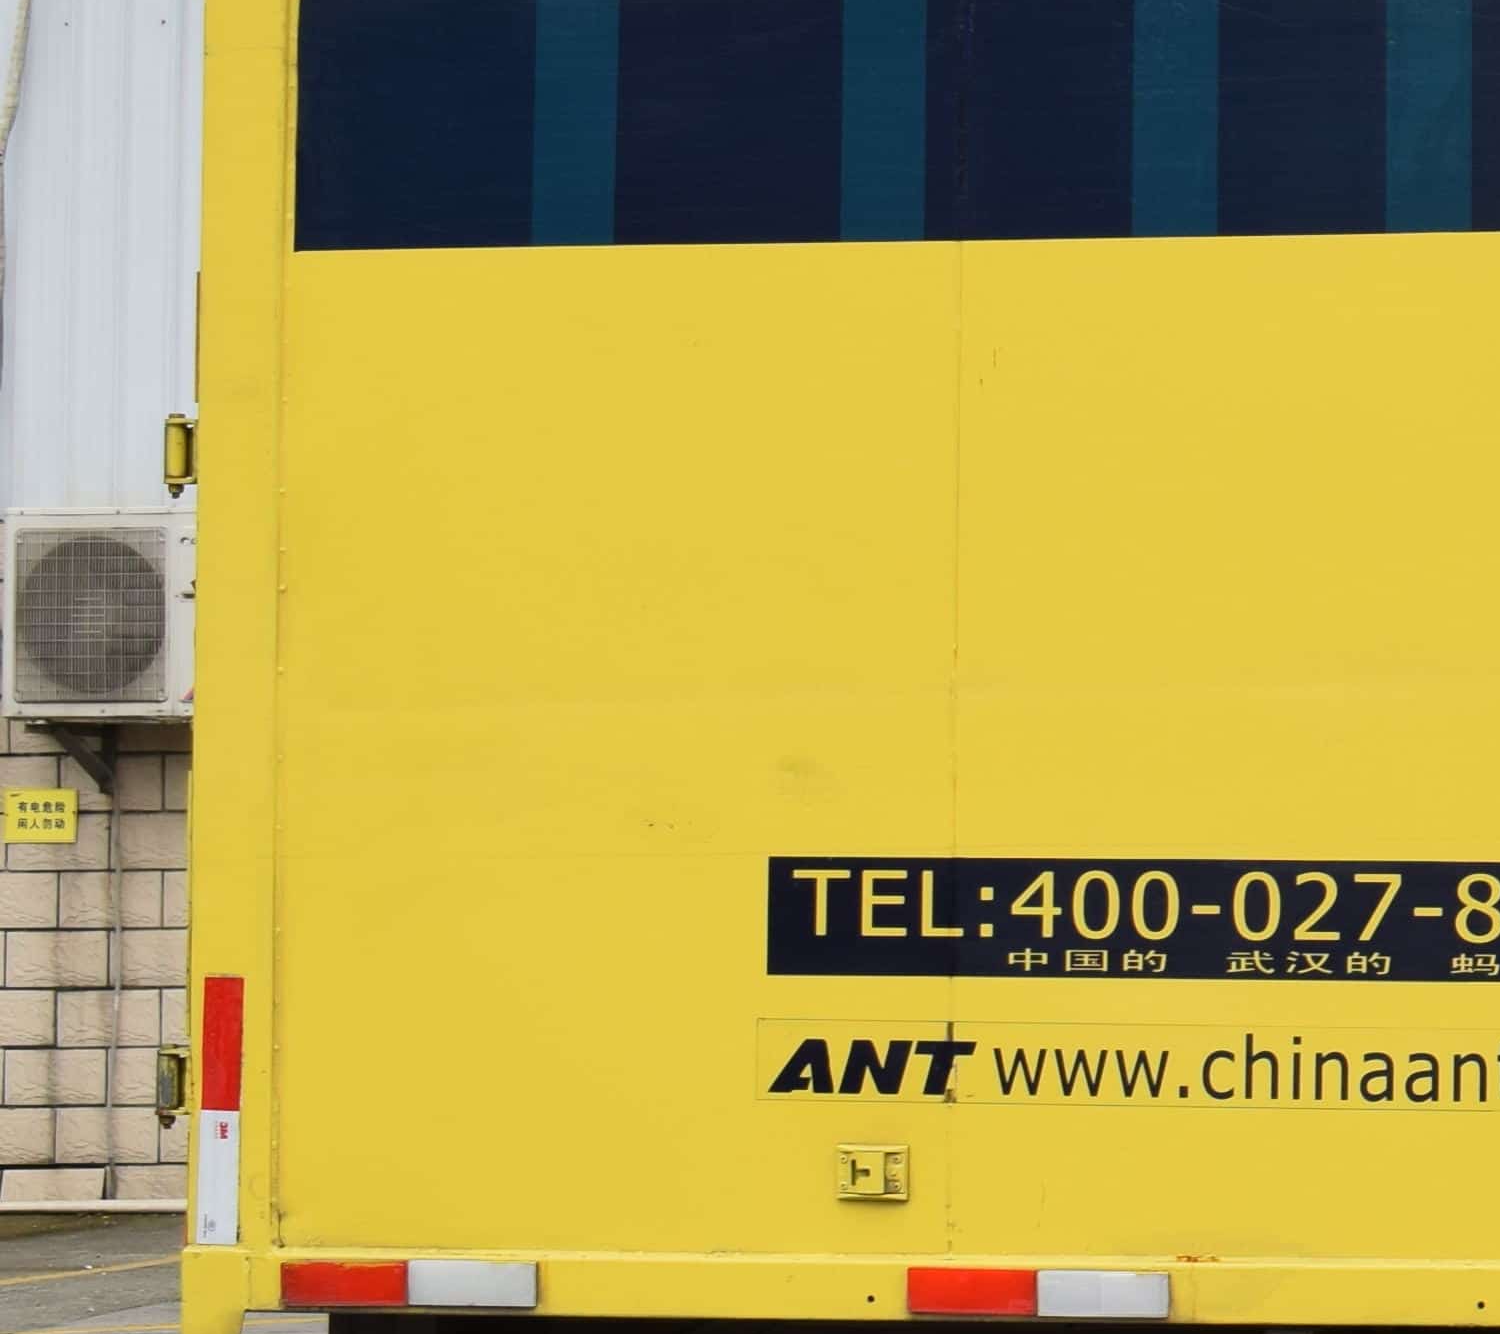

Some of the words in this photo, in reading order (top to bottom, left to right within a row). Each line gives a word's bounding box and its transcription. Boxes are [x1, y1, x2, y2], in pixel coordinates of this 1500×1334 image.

[1008, 947, 1168, 973] 中国的
[1226, 950, 1393, 975] 武汉的
[768, 1038, 977, 1096] ANT
